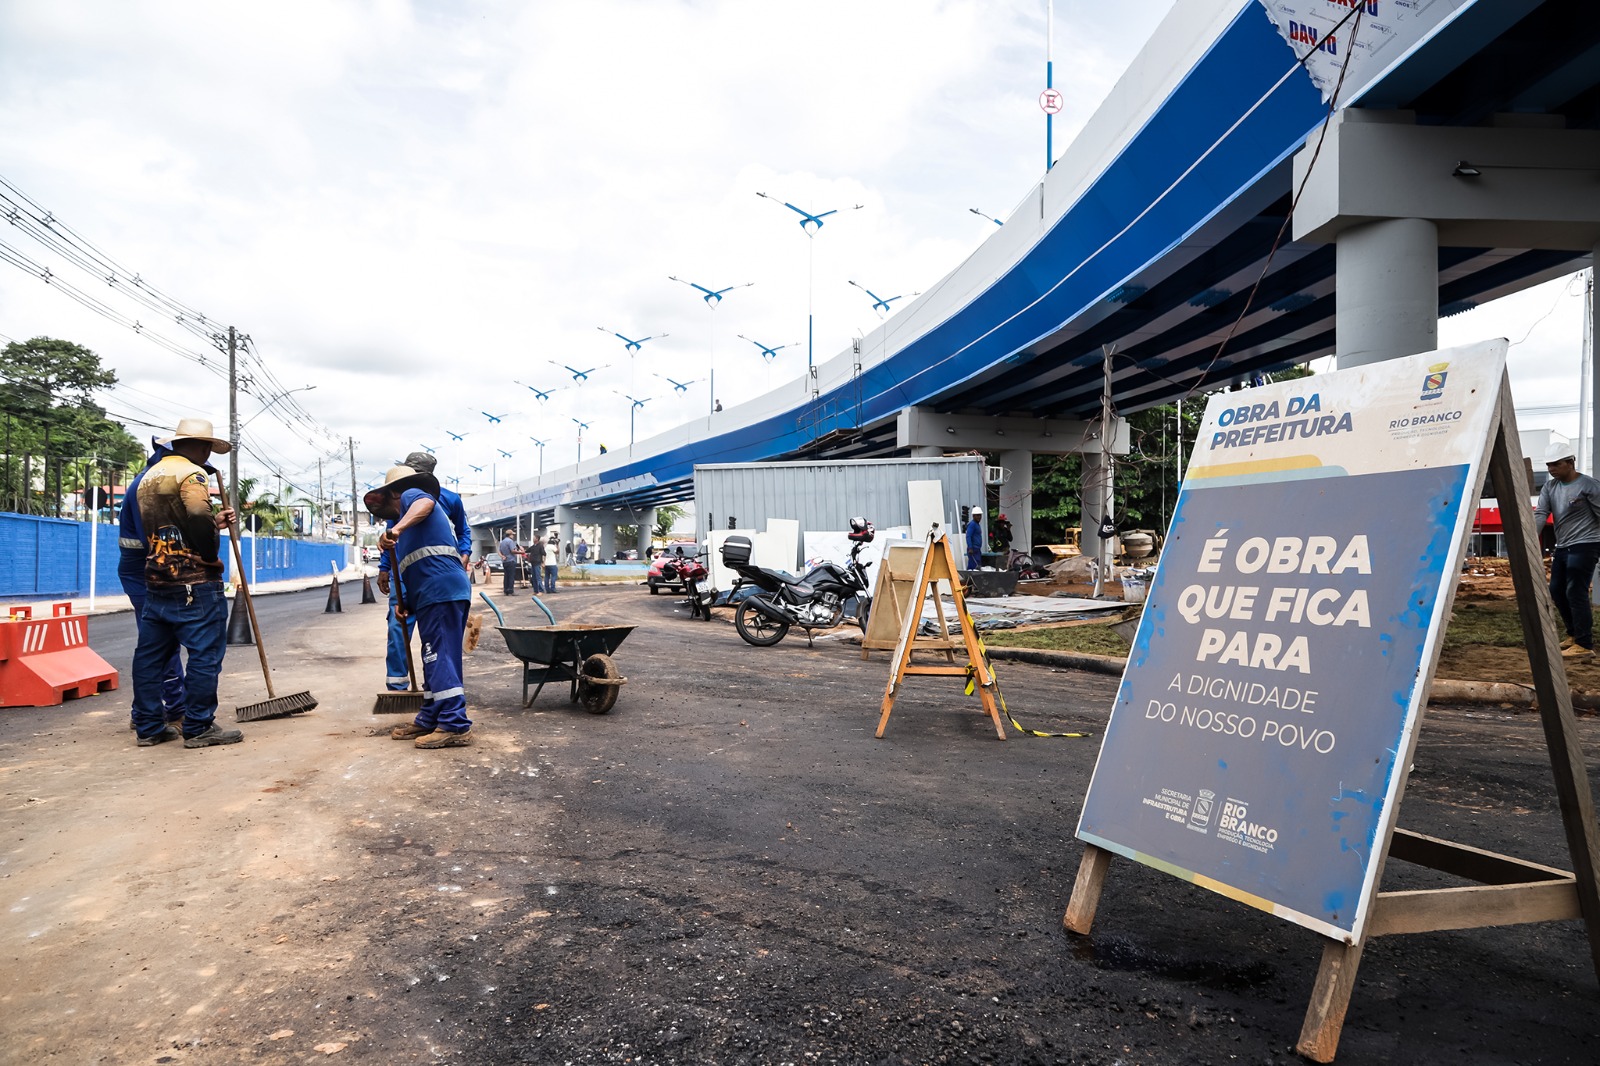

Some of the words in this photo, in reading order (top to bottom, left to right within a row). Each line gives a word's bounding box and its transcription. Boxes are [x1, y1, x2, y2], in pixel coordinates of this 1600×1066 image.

[1218, 401, 1279, 427] OBRA
[1285, 393, 1321, 417] DA
[1389, 418, 1410, 429] RIO
[1411, 410, 1462, 426] BRANCO
[1210, 412, 1353, 450] PREFEITURA
[1197, 529, 1230, 573] É
[1235, 534, 1372, 574] OBRA
[1177, 584, 1260, 625] QUE
[1264, 587, 1371, 628] FICA
[1196, 628, 1311, 674] PARA
[1167, 672, 1182, 692] A
[1187, 674, 1319, 714] DIGNIDADE
[1145, 699, 1177, 722] DO
[1180, 706, 1256, 738] NOSSO
[1261, 720, 1336, 753] POVO
[1219, 814, 1279, 843] BRANCO
[1223, 802, 1247, 819] RIO
